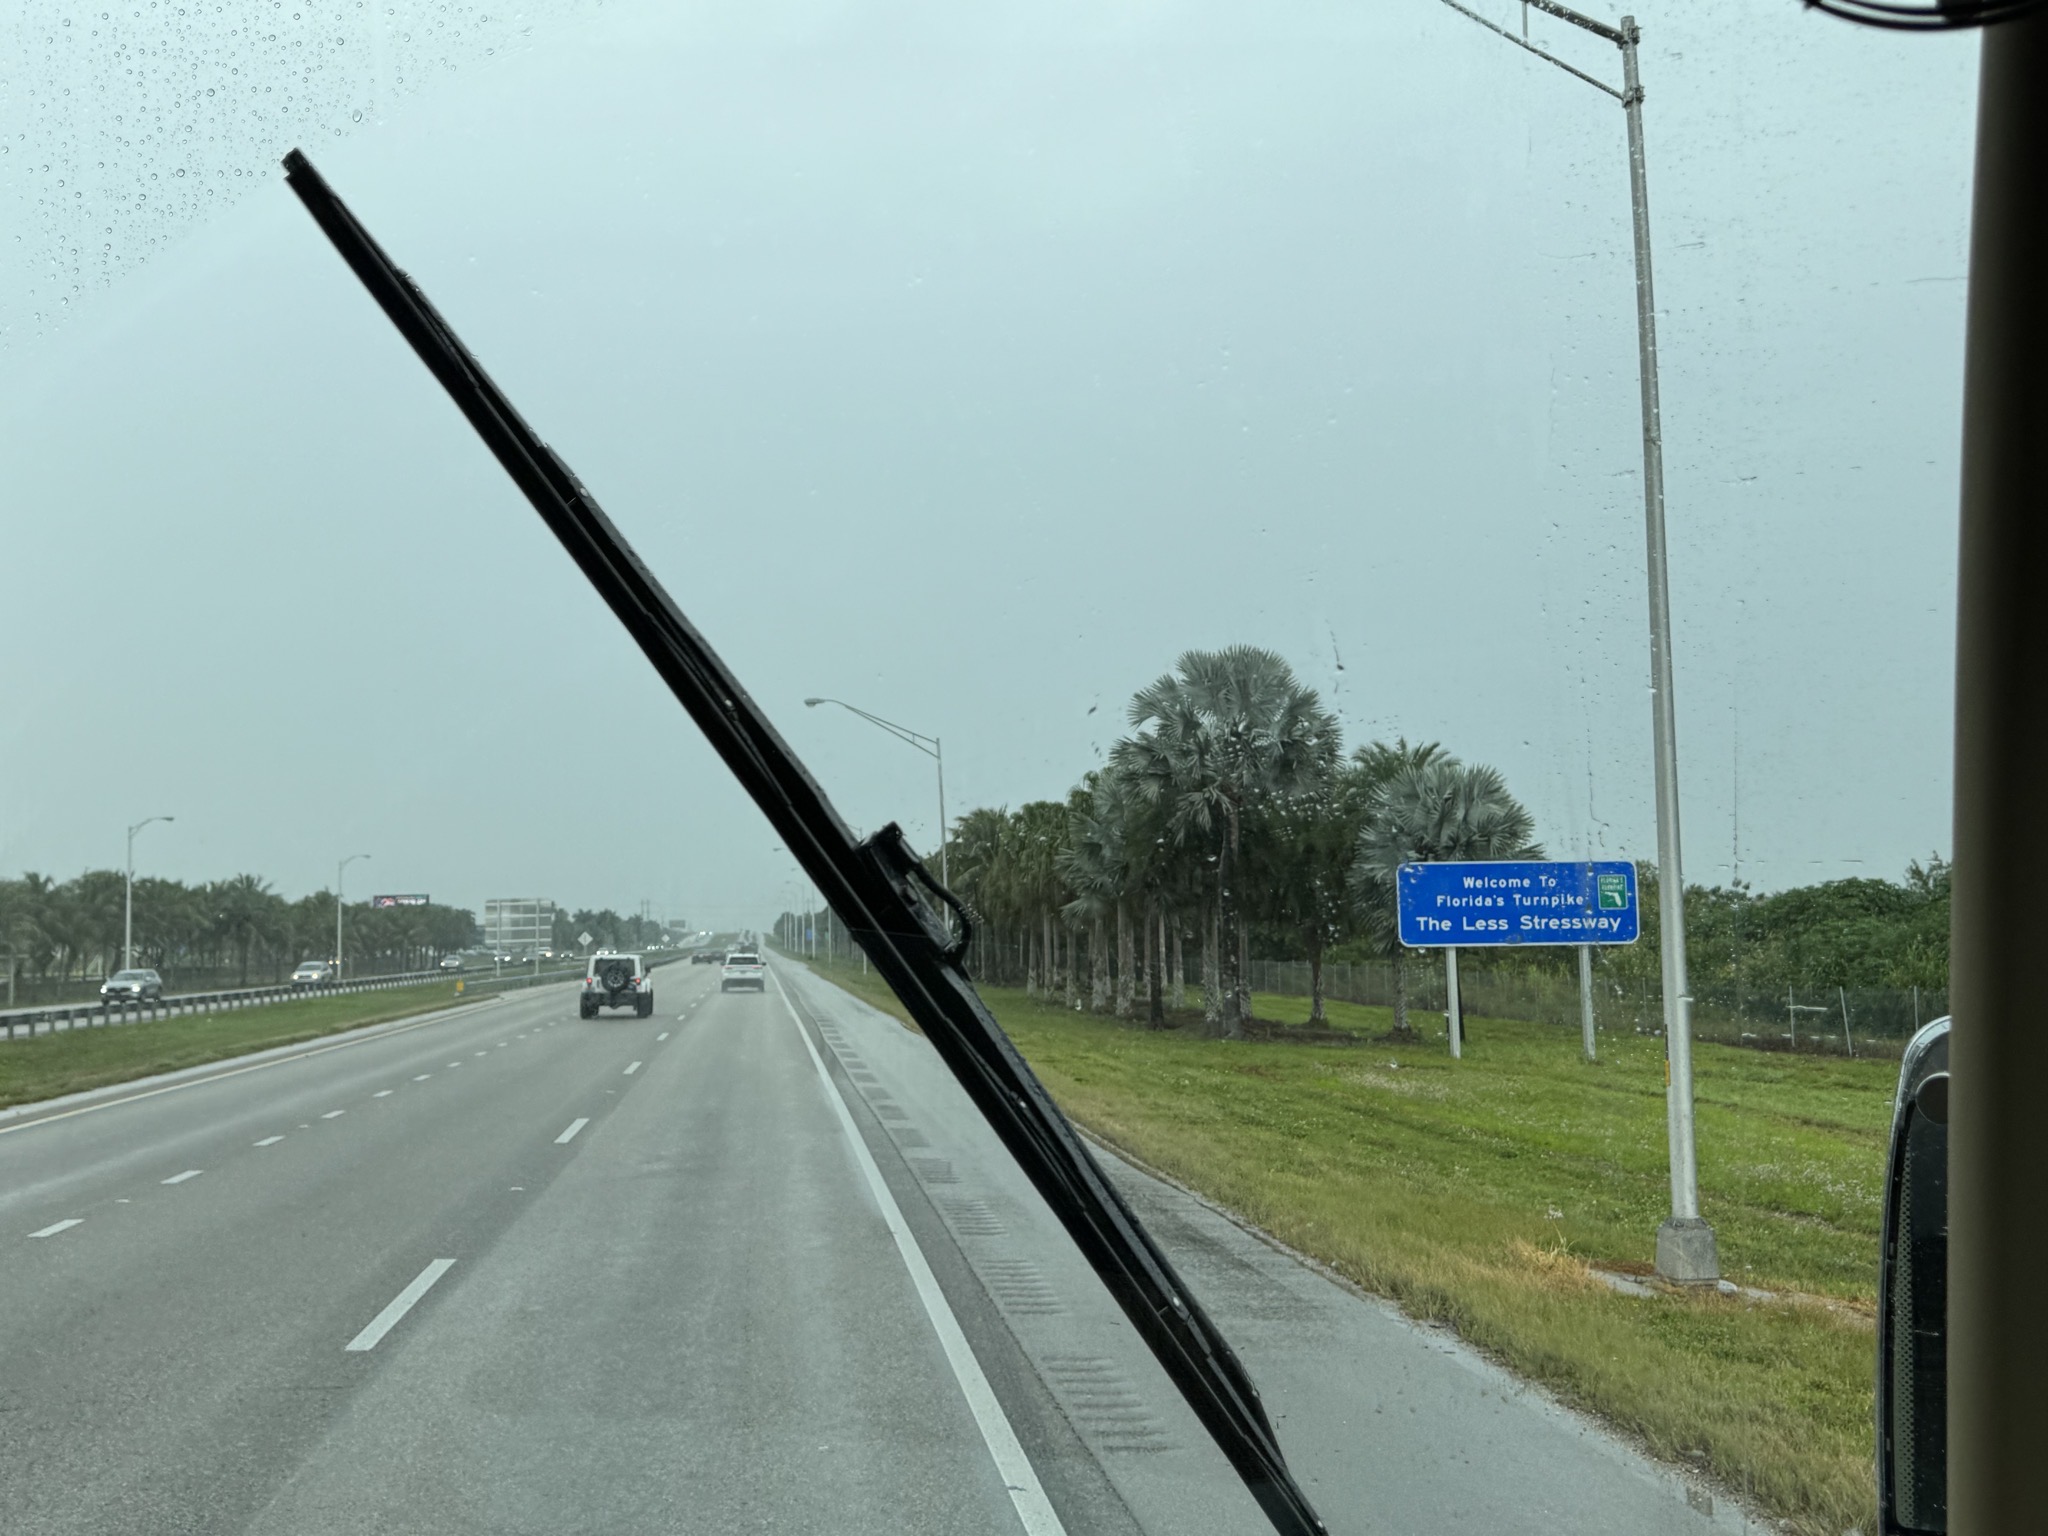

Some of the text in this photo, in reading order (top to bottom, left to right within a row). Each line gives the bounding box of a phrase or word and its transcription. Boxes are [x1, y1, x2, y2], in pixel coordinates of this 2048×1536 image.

[1463, 876, 1556, 889] Welcome To
[1437, 894, 1584, 907] Florida's Turnpike
[1416, 915, 1621, 931] The Less Stressway
